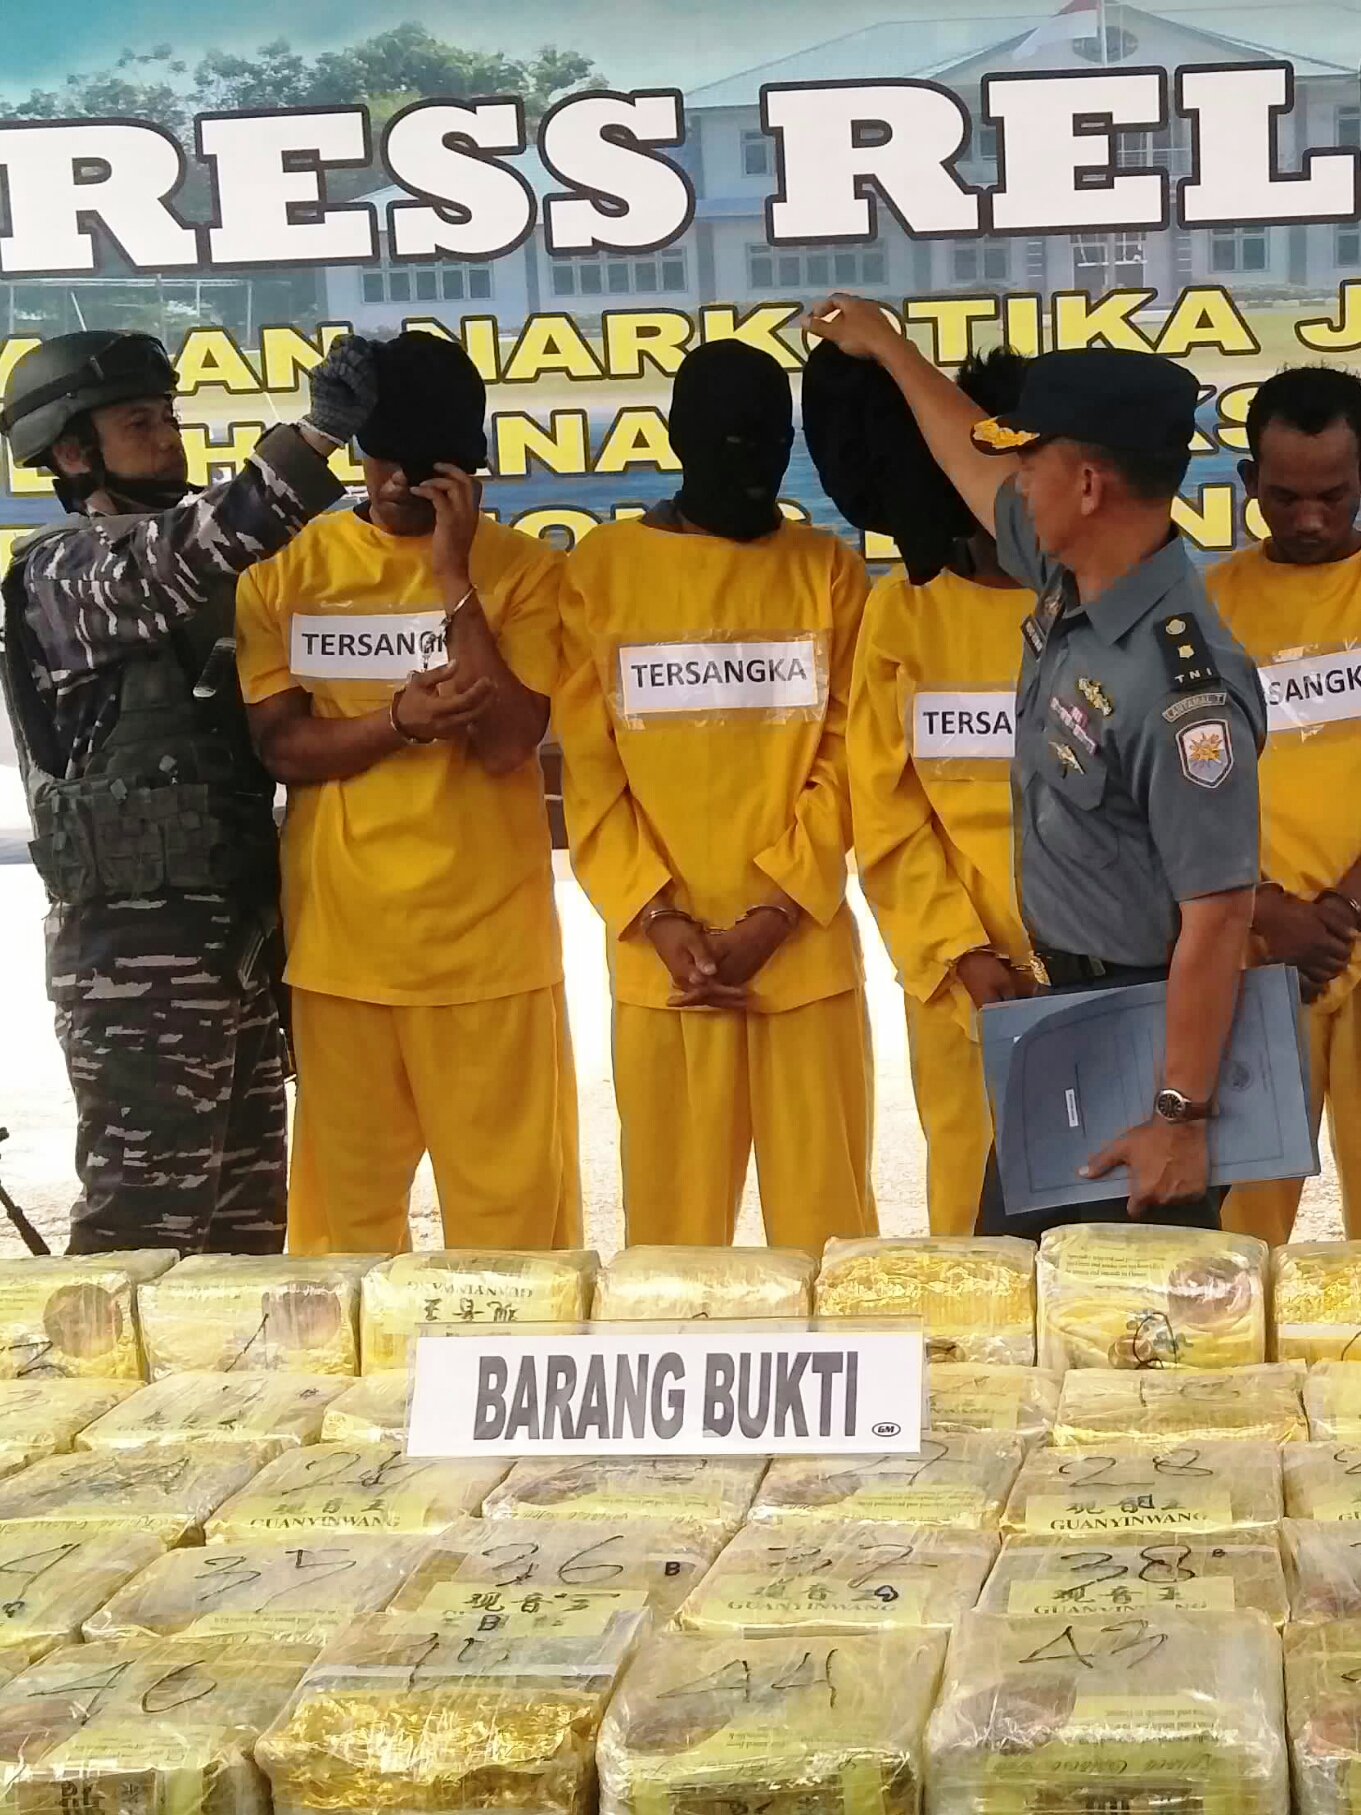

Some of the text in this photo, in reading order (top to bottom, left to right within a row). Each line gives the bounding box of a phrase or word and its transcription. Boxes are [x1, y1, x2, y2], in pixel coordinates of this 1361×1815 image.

[630, 657, 808, 689] TERSANGKA
[1174, 667, 1213, 684] TNI
[922, 710, 1014, 736] TERSA
[473, 1350, 860, 1441] BARANG BUKTI
[1049, 1511, 1208, 1530] GUANYINWANG
[1060, 1544, 1196, 1594] 38
